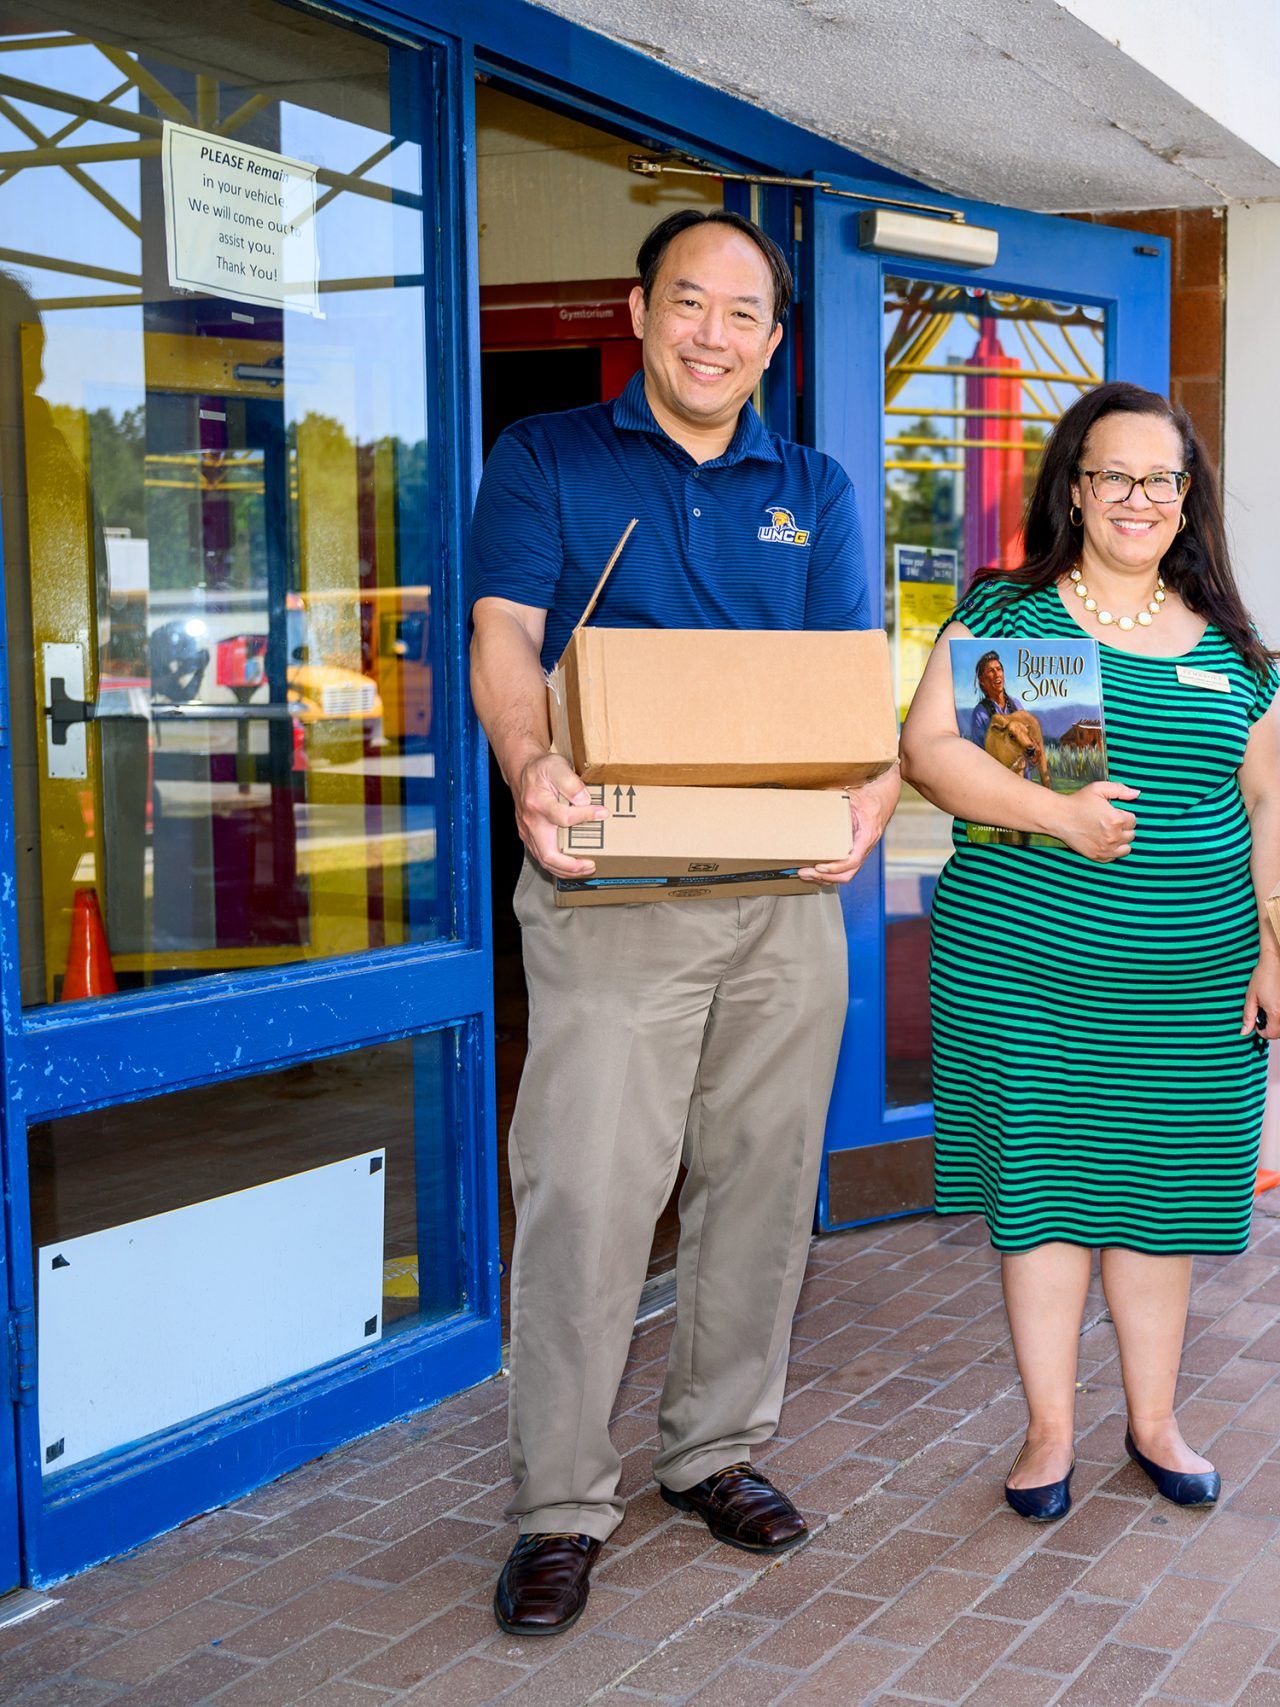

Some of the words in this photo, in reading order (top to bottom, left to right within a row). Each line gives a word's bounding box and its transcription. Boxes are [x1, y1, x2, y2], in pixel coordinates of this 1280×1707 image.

[200, 146, 244, 170] PLEASE
[246, 160, 289, 183] Remain
[203, 173, 214, 189] in
[217, 180, 241, 197] your
[188, 197, 209, 214] We
[213, 205, 231, 220] will
[233, 212, 264, 229] come
[267, 220, 287, 235] out
[218, 232, 245, 249] assist
[248, 240, 275, 256] you.
[216, 255, 246, 276] Thank
[249, 264, 278, 282] You!
[759, 527, 808, 545] UNCG
